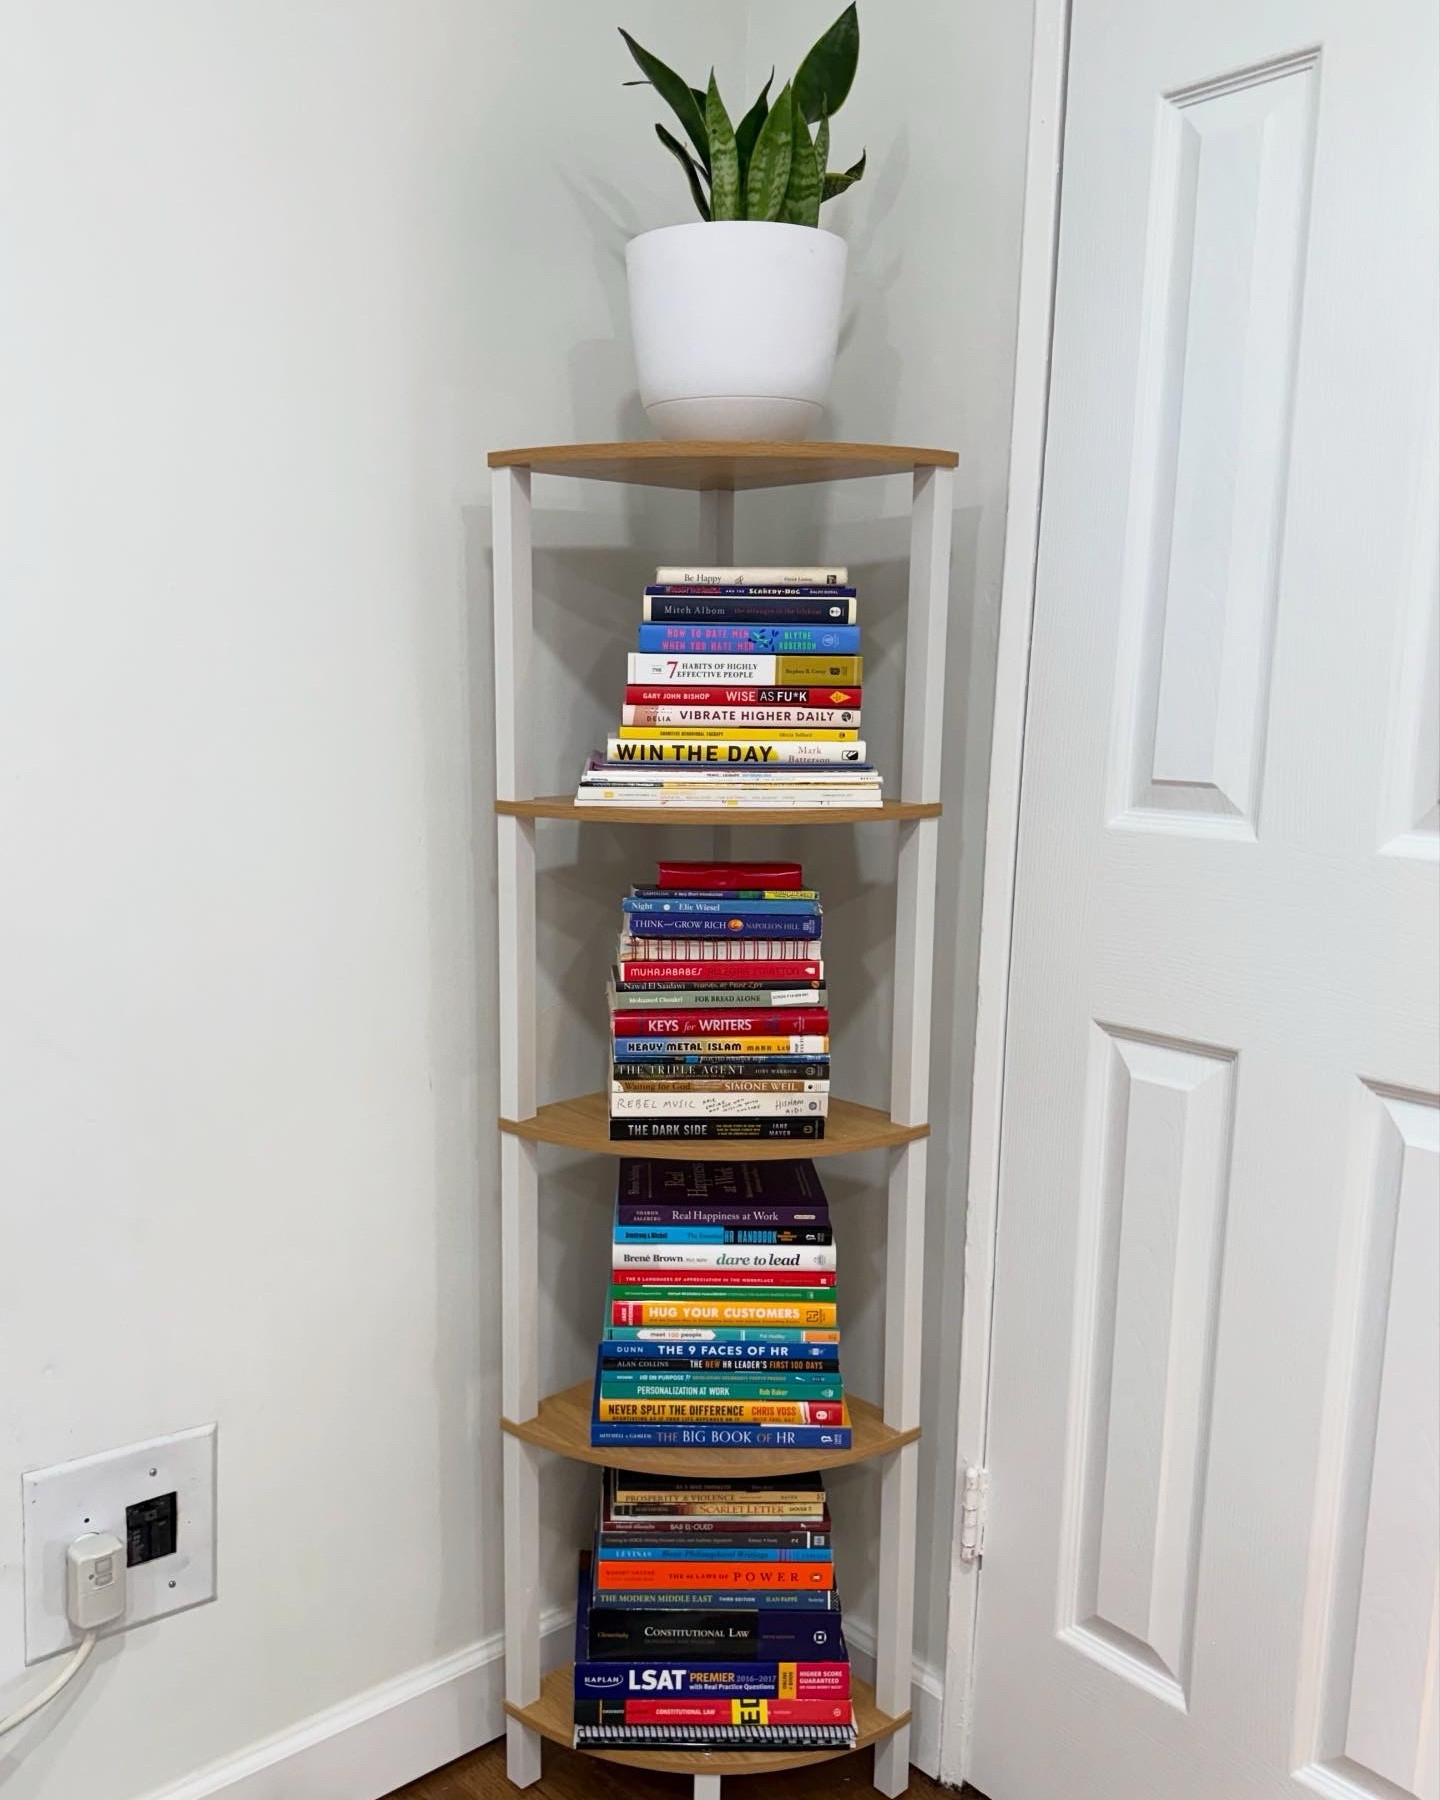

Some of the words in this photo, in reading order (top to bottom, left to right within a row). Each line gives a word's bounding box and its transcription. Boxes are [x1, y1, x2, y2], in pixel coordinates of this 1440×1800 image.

[684, 574, 694, 582] Be
[697, 574, 721, 584] Happy
[664, 605, 691, 615] Mitch
[694, 605, 726, 615] Albom
[667, 628, 685, 638] HOW
[692, 628, 703, 638] TO
[706, 628, 727, 638] DATE
[732, 629, 749, 638] MEN
[784, 631, 812, 640] BLYTHE
[662, 642, 685, 650] WHEN
[690, 642, 704, 650] YOU
[710, 642, 731, 650] HATE
[736, 642, 754, 650] MEN
[778, 642, 816, 650] ROBERSON
[666, 661, 678, 678] 7
[726, 690, 756, 702] WISE
[760, 691, 774, 702] AS
[680, 711, 736, 720] VIBRATE
[741, 711, 790, 721] HIGHER
[797, 712, 834, 722] DAILY
[616, 744, 664, 761] WIN
[672, 744, 719, 762] THE
[728, 746, 773, 762] DAY
[788, 756, 830, 764] Batterson
[632, 902, 652, 912] Night
[679, 903, 694, 912] Elie
[697, 904, 720, 912] Wiesel
[634, 920, 664, 928] THINK
[675, 920, 702, 929] GROW
[704, 921, 726, 930] RICH
[746, 922, 784, 930] NAPOLEON
[630, 968, 702, 976] MUHAJABABES
[624, 982, 646, 990] Nawal
[648, 1020, 678, 1032] KEYS
[682, 1021, 696, 1033] for
[699, 1020, 752, 1031] WRITERS
[628, 1042, 664, 1052] HEAVY
[667, 1043, 702, 1052] METAL
[708, 1043, 742, 1051] ISLAM
[620, 1065, 644, 1074] THE
[651, 1065, 696, 1074] TRIPLE
[702, 1065, 745, 1074] AGENT
[624, 1082, 655, 1092] Waiting
[658, 1082, 670, 1090] for
[672, 1082, 690, 1090] God
[724, 1082, 768, 1091] SIMONE
[772, 1082, 797, 1091] WEIL
[618, 1098, 657, 1110] REBEL
[664, 1100, 697, 1110] MUSIC
[628, 1124, 648, 1136] THE
[652, 1124, 680, 1136] DARK
[684, 1124, 708, 1136] SIDE
[673, 1210, 692, 1220] Real
[694, 1210, 740, 1223] Happiness
[742, 1212, 750, 1220] at
[753, 1212, 778, 1221] Work
[738, 1230, 778, 1244] HANDBOOK
[624, 1254, 650, 1262] Brené
[653, 1254, 684, 1262] Brown
[716, 1254, 750, 1266] dare
[754, 1256, 766, 1266] to
[769, 1254, 800, 1266] lead
[649, 1308, 678, 1318] HUG
[682, 1308, 718, 1318] YOUR
[724, 1308, 800, 1319] CUSTOMERS
[658, 1346, 684, 1354] THE
[688, 1346, 696, 1355] 9
[701, 1346, 742, 1355] FACES
[747, 1346, 766, 1355] OF
[770, 1346, 788, 1356] HR
[690, 1360, 702, 1368] THE
[705, 1360, 720, 1368] NEW
[722, 1361, 732, 1369] HR
[734, 1361, 768, 1370] LEADER'S
[769, 1362, 788, 1370] FIRST
[791, 1362, 804, 1370] 100
[806, 1362, 824, 1370] DAYS
[637, 1386, 698, 1396] PERSONALIZATION
[698, 1387, 707, 1395] AT
[710, 1387, 730, 1396] WORK
[608, 1404, 637, 1416] NEVER
[640, 1404, 666, 1416] SPLIT
[668, 1405, 686, 1416] THE
[690, 1405, 744, 1416] DIFFERENCE
[751, 1406, 774, 1416] CHRIS
[776, 1406, 797, 1416] VOSS
[656, 1432, 678, 1443] THE
[684, 1430, 706, 1442] BIG
[712, 1431, 752, 1443] BOOK
[757, 1432, 772, 1443] OF
[776, 1432, 796, 1444] HR
[700, 1504, 744, 1514] SCARLET
[746, 1502, 784, 1514] LETTER
[734, 1572, 800, 1582] POWER
[618, 1594, 656, 1602] MODERN
[658, 1594, 690, 1602] MIDDLE
[692, 1594, 713, 1602] EAST
[644, 1626, 726, 1638] CONSTITUTIONAL
[729, 1628, 750, 1638] LAW
[628, 1670, 687, 1690] LSAT
[690, 1672, 735, 1682] PREMIER
